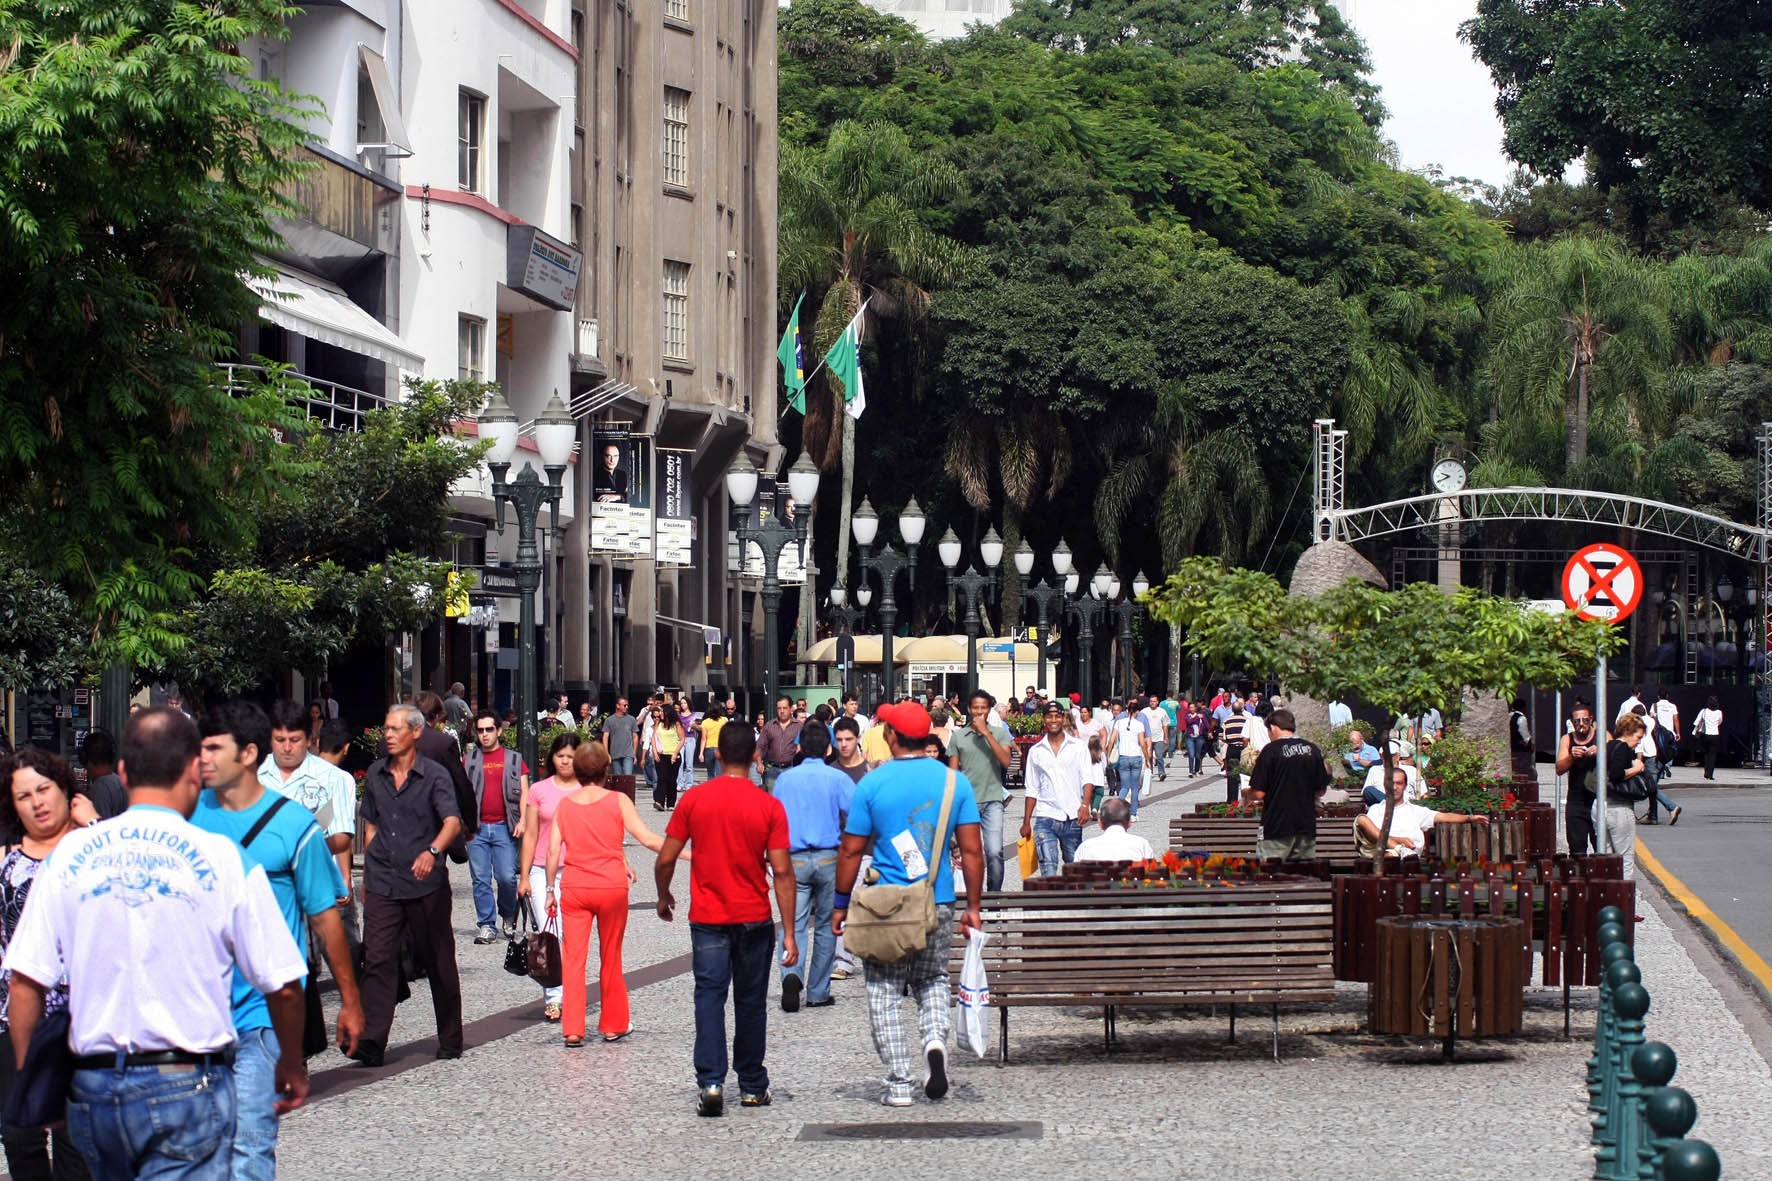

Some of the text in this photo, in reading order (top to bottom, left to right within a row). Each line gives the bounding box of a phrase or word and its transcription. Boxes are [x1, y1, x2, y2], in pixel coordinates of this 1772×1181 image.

[667, 455, 675, 517] 0800 702 0501
[68, 827, 210, 880] ABOUT CALIFORNIA
